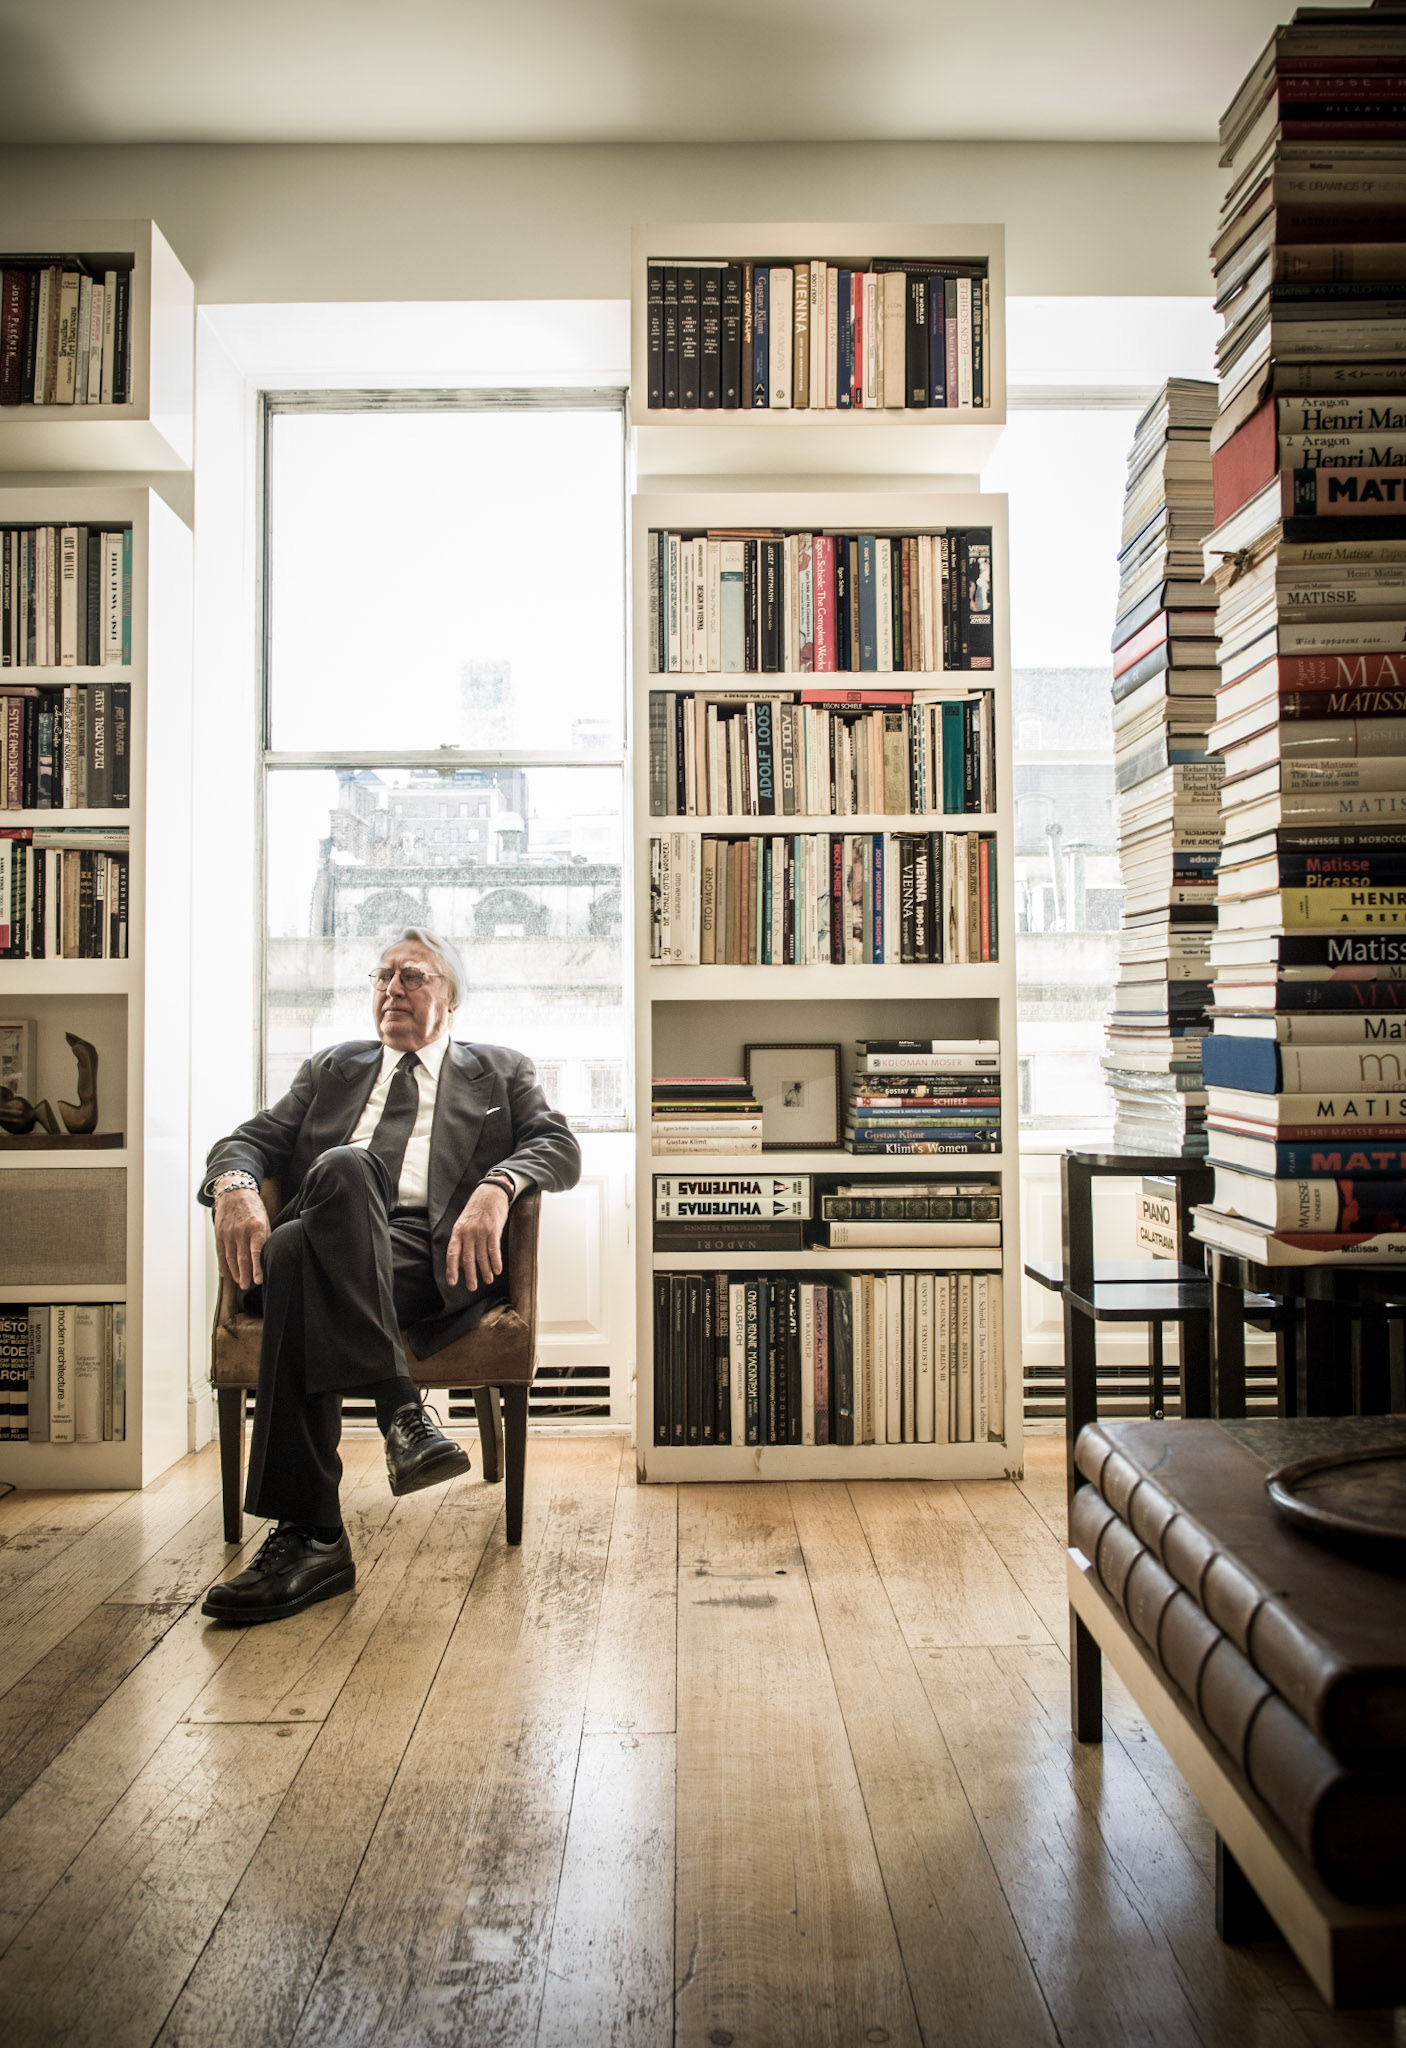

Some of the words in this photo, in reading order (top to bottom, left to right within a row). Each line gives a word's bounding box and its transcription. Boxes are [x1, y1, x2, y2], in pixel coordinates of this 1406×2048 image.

[1288, 182, 1305, 191] THE
[1308, 182, 1359, 191] DRAWINGS
[1362, 182, 1374, 191] OF
[10, 284, 20, 313] JOSIP
[756, 276, 767, 307] Gustav
[795, 273, 807, 334] VIENNA
[959, 282, 969, 324] SCHIELE
[756, 309, 767, 335] Klimt
[59, 318, 68, 357] Bruxelles
[959, 327, 969, 355] EGON
[67, 344, 77, 358] Art
[1301, 397, 1350, 408] Aragon
[1301, 409, 1363, 430] Henri
[1368, 407, 1406, 429] Ma
[1285, 436, 1293, 447] 2
[1302, 435, 1350, 448] Aragon
[1302, 448, 1364, 467] Henri
[1368, 447, 1406, 467] Ma
[63, 536, 75, 549] ART
[815, 538, 826, 559] Egon
[1302, 548, 1332, 561] Henri
[1334, 548, 1373, 561] Matisse
[63, 551, 75, 580] NOUVEAU
[650, 557, 658, 590] VIENNA
[816, 559, 826, 590] Schiele:
[1347, 569, 1370, 578] Henri
[816, 590, 826, 608] The
[1287, 590, 1357, 605] MATISSE
[816, 608, 826, 645] Complete
[816, 645, 826, 670] Works
[94, 690, 105, 713] ART
[1326, 691, 1406, 713] MATISS
[8, 709, 19, 739] STYLE
[757, 705, 771, 746] LOOS
[782, 714, 793, 753] ADOLF
[8, 739, 19, 760] AND
[94, 716, 105, 769] NOUVEAU
[8, 760, 19, 792] DESIGN
[758, 749, 773, 798] ADOLF
[782, 757, 793, 789] LOOS
[970, 837, 978, 850] THE
[1298, 835, 1340, 846] MATISSE
[1343, 835, 1355, 846] IN
[662, 841, 670, 872] WAGNERS
[970, 850, 978, 875] SACRED
[1305, 857, 1371, 872] Matisse
[662, 873, 670, 891] OTTO
[703, 867, 713, 904] WAGNER
[772, 870, 782, 902] ADOLF
[915, 855, 927, 903] VIENNA
[1305, 873, 1372, 888] Picasso
[902, 865, 914, 919] VIENNA
[703, 906, 713, 931] OTTO
[772, 907, 782, 937] LOOS
[915, 905, 925, 946] 1890-1920
[1340, 914, 1349, 922] A
[882, 1059, 928, 1067] KOLOMAN
[931, 1059, 963, 1067] MOSER
[884, 1087, 909, 1095] GUSTAV
[932, 1098, 968, 1106] SCHIELE
[864, 1130, 896, 1139] Gustav
[898, 1130, 924, 1139] Klimt
[1297, 1128, 1329, 1137] HENRI
[1331, 1128, 1373, 1137] MATISSE
[926, 1143, 968, 1153] Women
[678, 1181, 762, 1195] VHUTEMAS
[678, 1202, 762, 1216] VHUTEMAS
[1142, 1200, 1171, 1225] PIANO
[1298, 1181, 1311, 1229] MATISSE
[1140, 1226, 1175, 1252] CALATRAVA
[1341, 1244, 1379, 1253] Matisse
[747, 1290, 758, 1321] CHARLES
[978, 1300, 987, 1329] Schinkel
[57, 1309, 66, 1347] modern
[735, 1304, 743, 1347] OLBRICH
[747, 1323, 758, 1348] RENNIE
[0, 1345, 26, 1357] ODE
[978, 1334, 987, 1348] Das
[57, 1347, 66, 1400] architecture
[747, 1351, 758, 1398] MACKINTOSH
[978, 1406, 987, 1438] Lehrbuch
